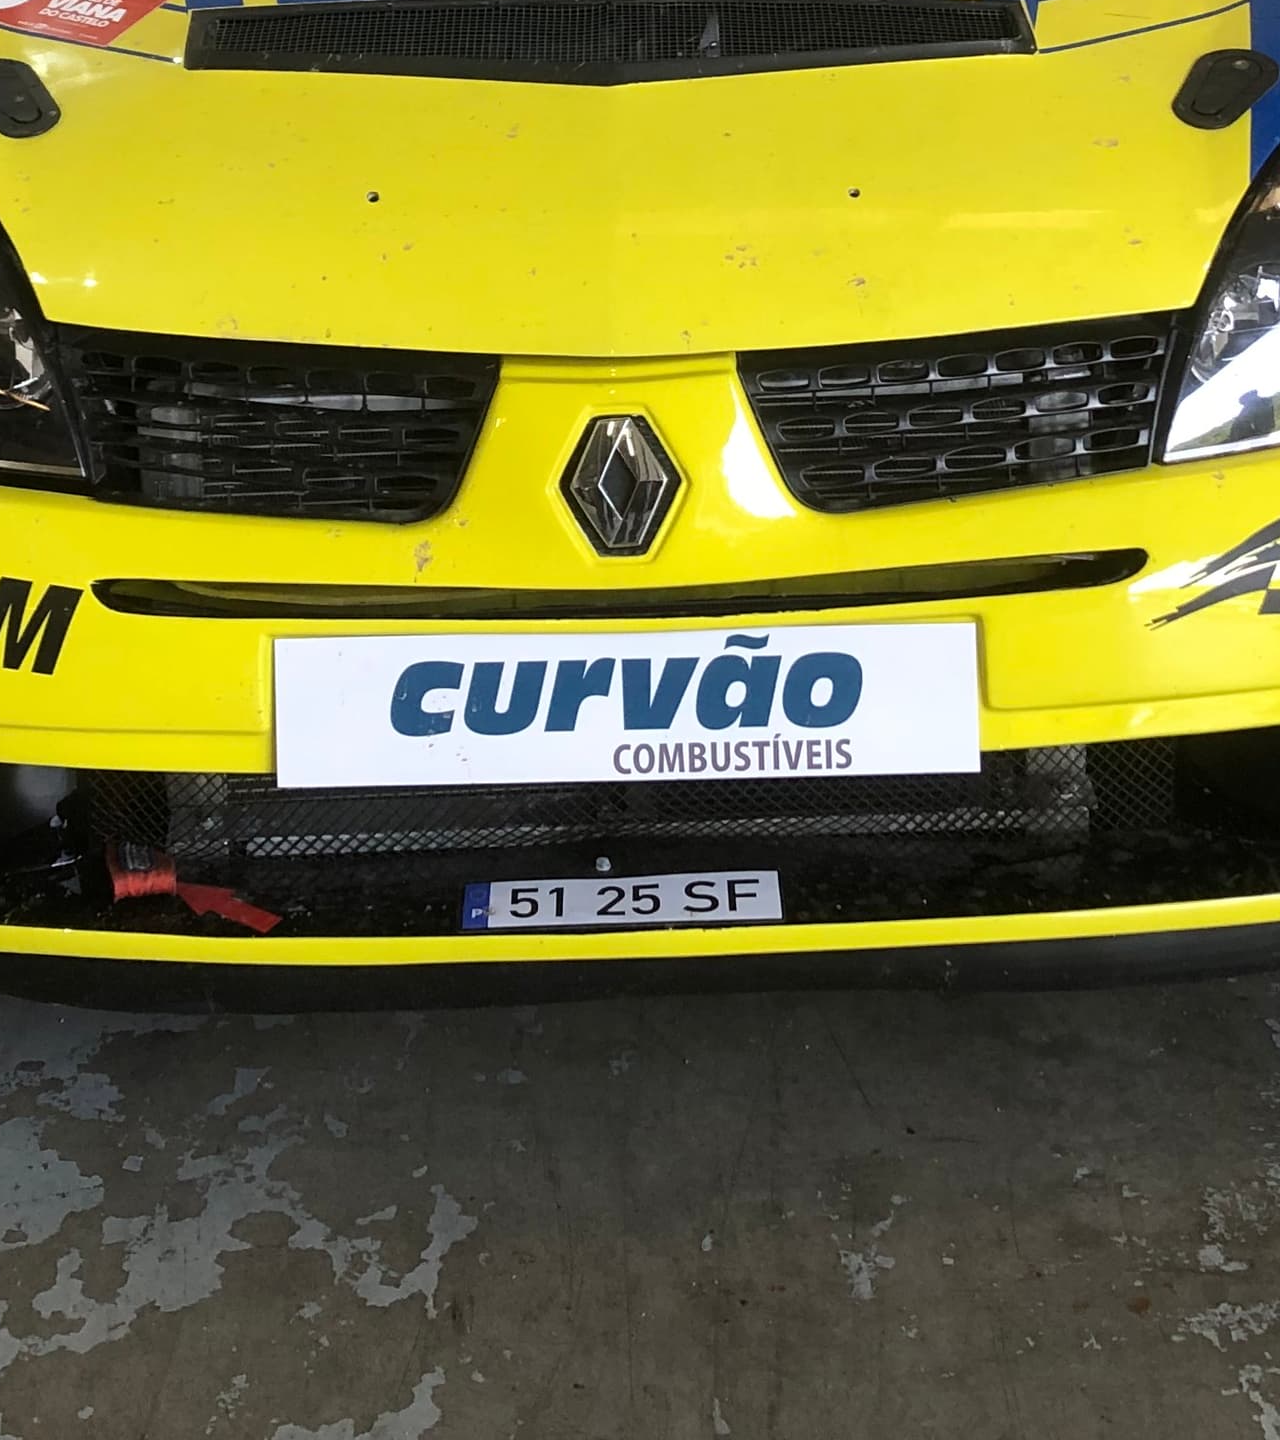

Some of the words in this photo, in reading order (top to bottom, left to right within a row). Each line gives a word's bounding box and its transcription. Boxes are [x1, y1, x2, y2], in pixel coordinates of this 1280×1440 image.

[38, 7, 60, 18] DO
[58, 9, 111, 28] CASTELO
[389, 633, 865, 739] curvão
[611, 733, 854, 776] COMBUSTÍVEIS
[470, 907, 484, 920] P
[508, 885, 568, 920] 51
[595, 882, 662, 917] 25
[682, 878, 762, 913] SF
